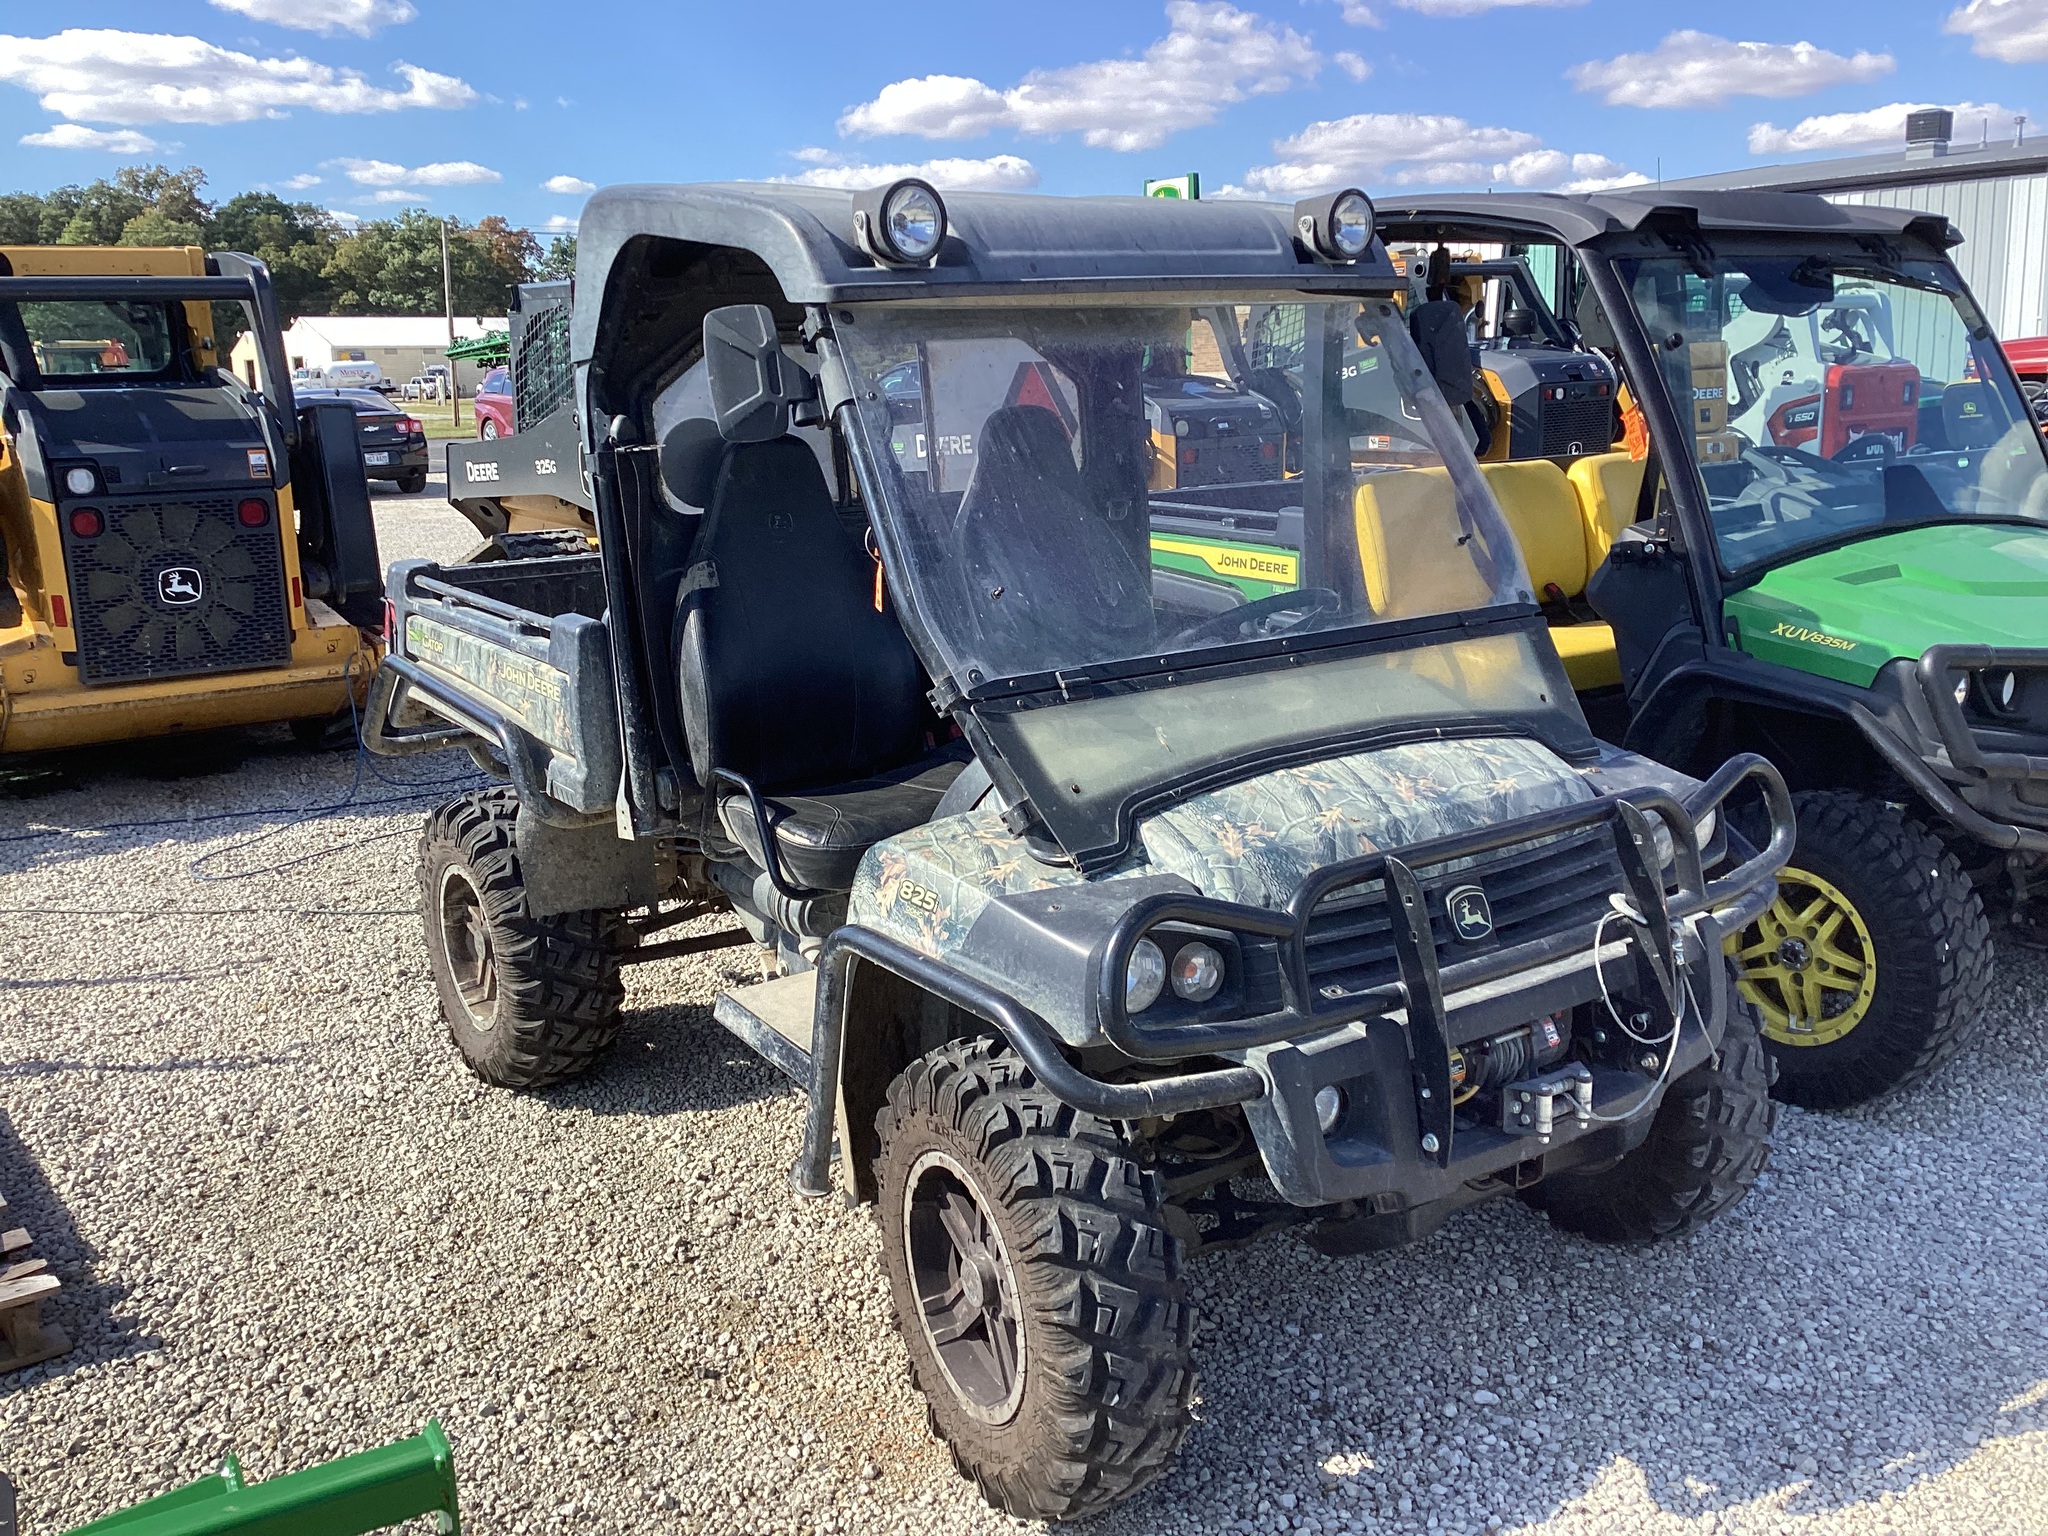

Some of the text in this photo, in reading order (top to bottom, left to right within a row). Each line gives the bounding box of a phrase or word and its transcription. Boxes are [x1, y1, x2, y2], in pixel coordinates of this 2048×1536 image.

[915, 433, 973, 459] DERE
[465, 460, 500, 482] DEERE
[534, 458, 557, 475] 325G
[1217, 553, 1289, 575] JOHN DEERE
[422, 636, 444, 653] GATOR
[1769, 622, 1857, 651] XUV835M
[498, 661, 562, 703] JOHN DEERE
[899, 879, 940, 914] 825i
